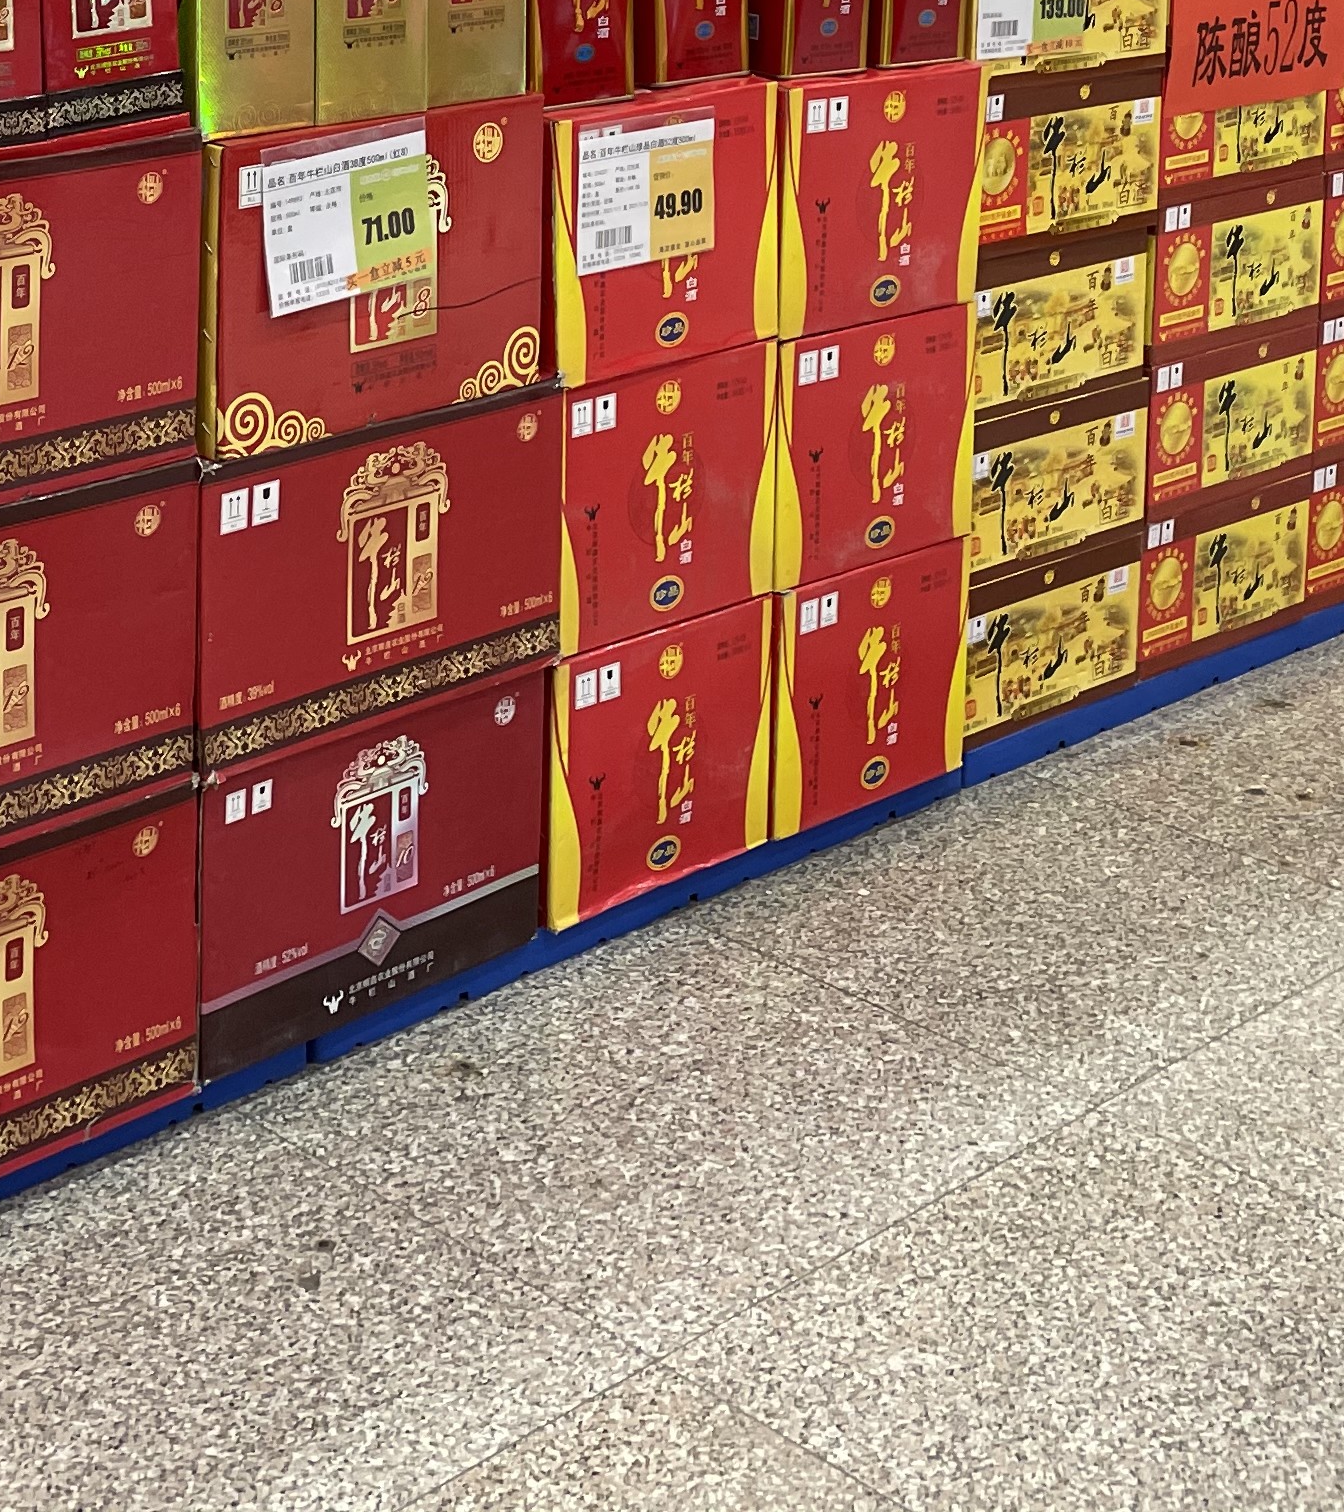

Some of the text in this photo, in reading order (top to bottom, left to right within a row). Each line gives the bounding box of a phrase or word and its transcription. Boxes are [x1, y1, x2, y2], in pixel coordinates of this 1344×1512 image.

[653, 186, 704, 220] 49.90
[361, 207, 416, 246] 71.00
[414, 249, 427, 265] 元
